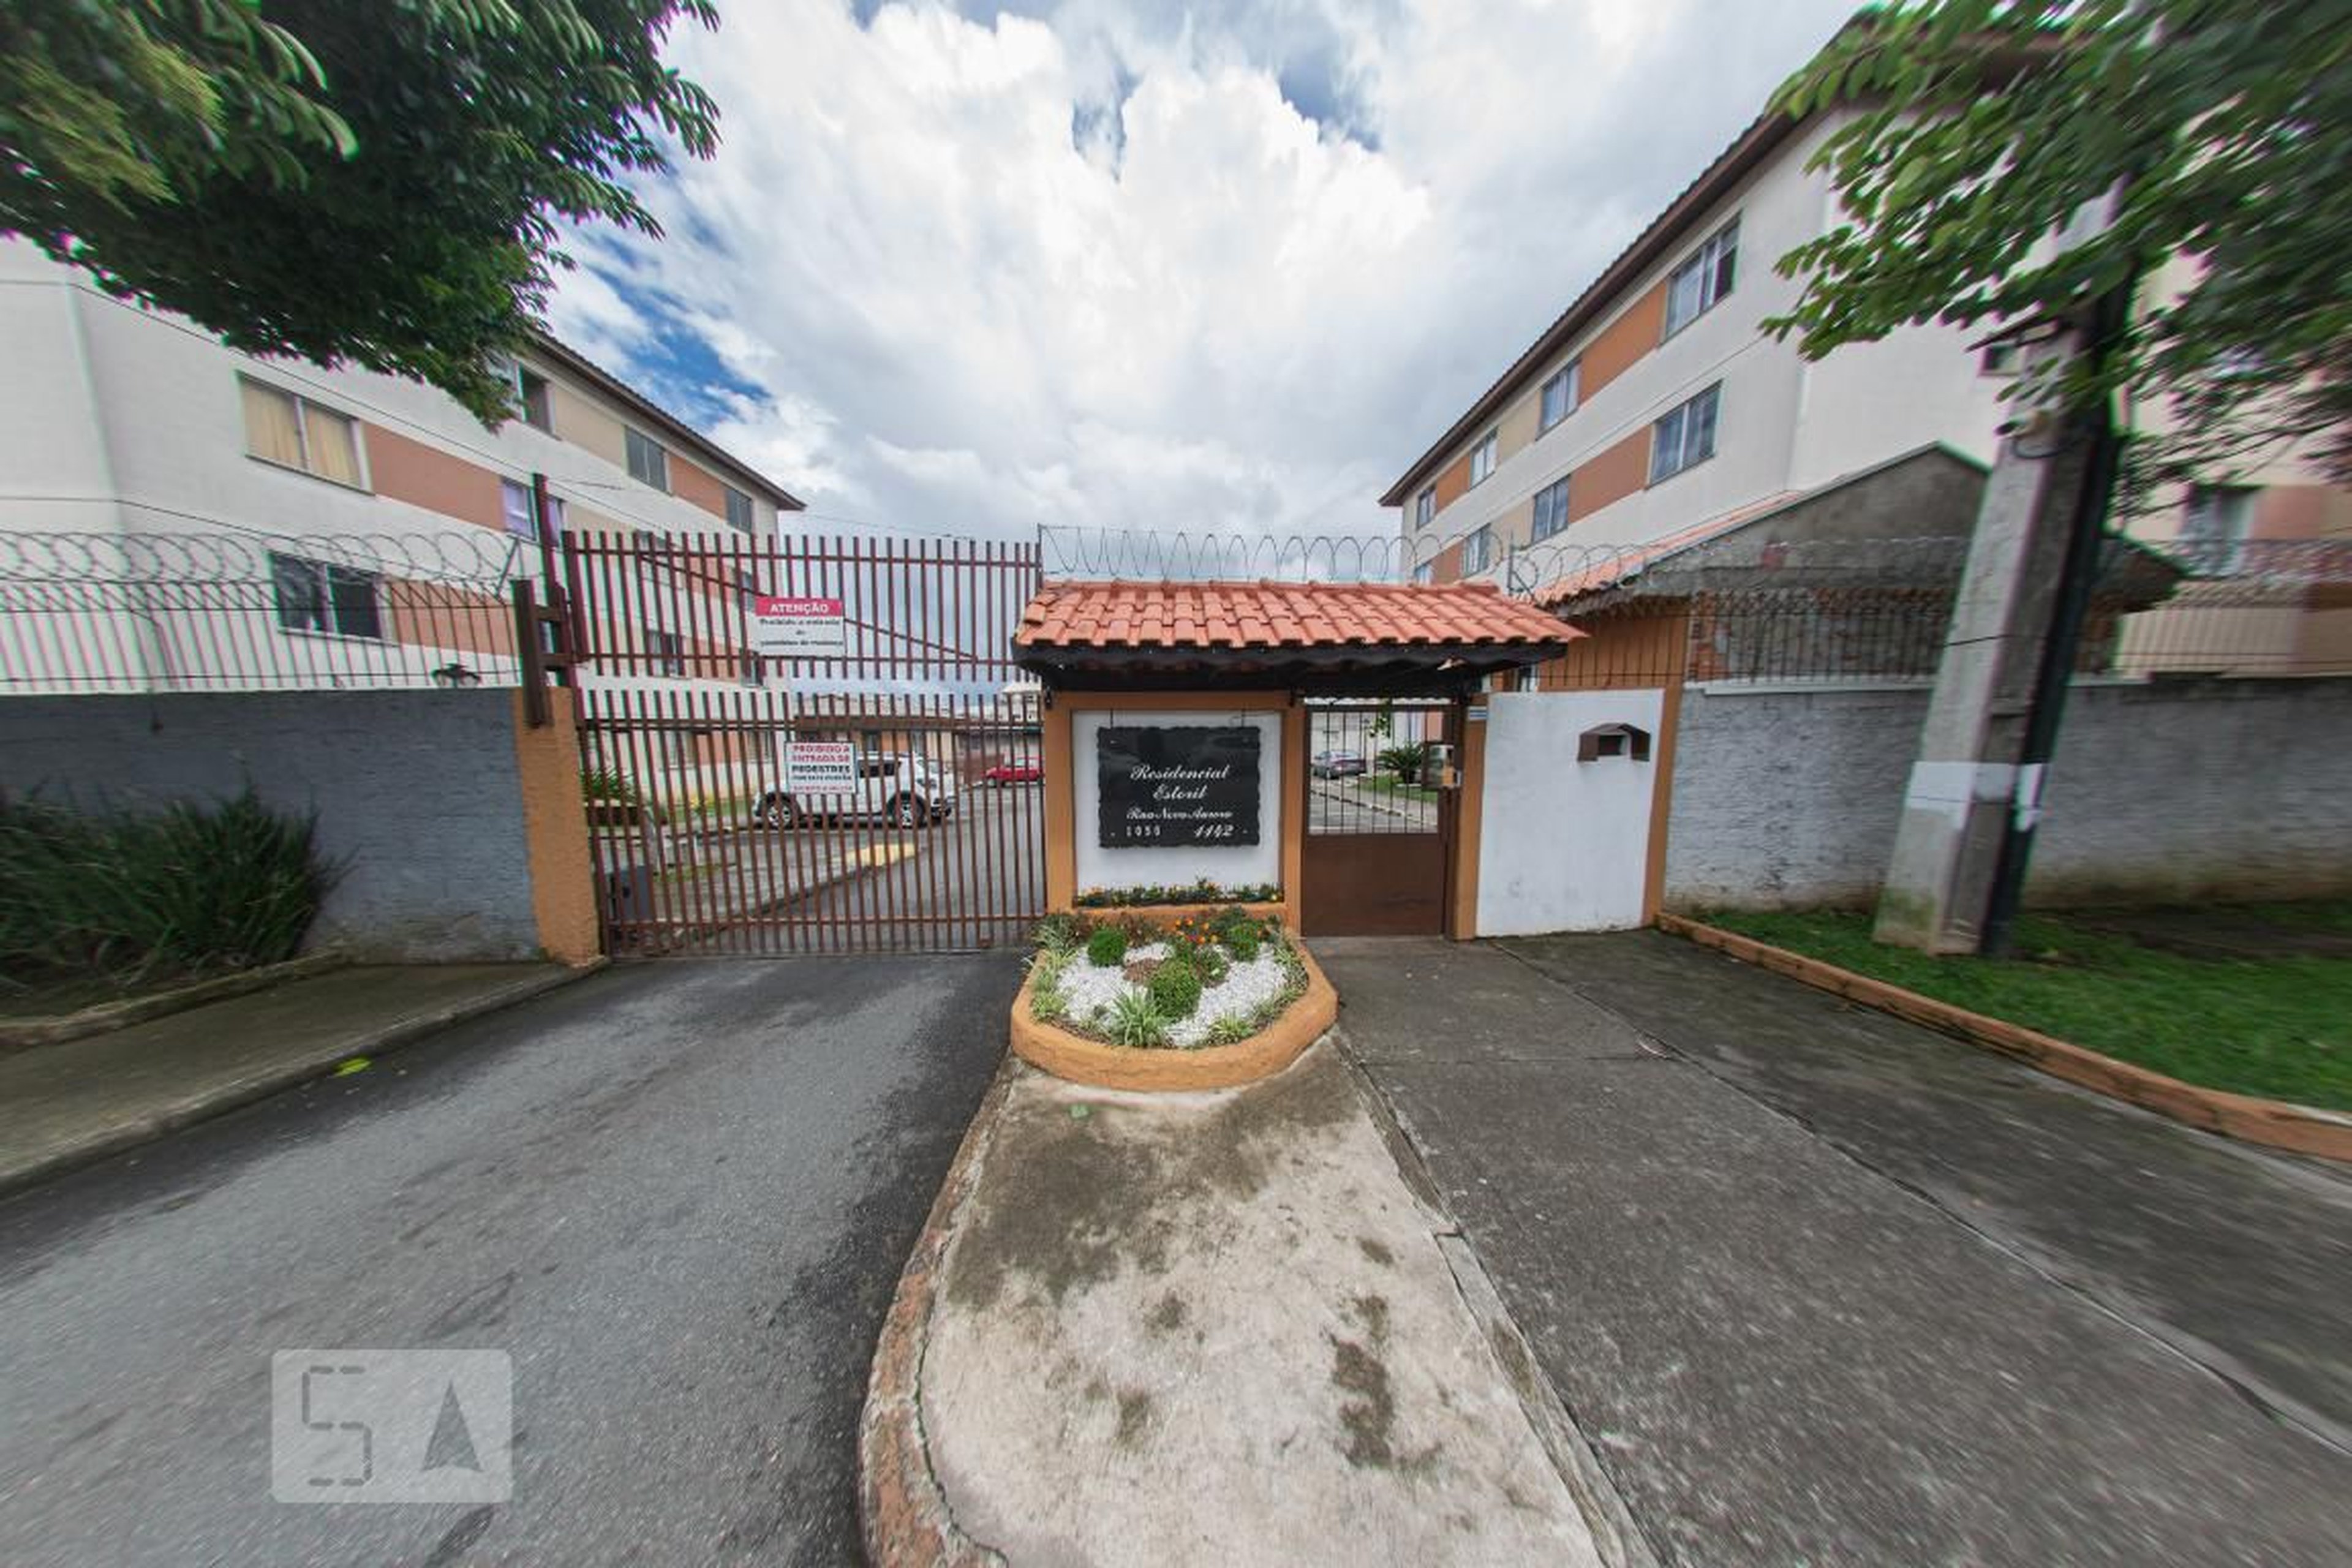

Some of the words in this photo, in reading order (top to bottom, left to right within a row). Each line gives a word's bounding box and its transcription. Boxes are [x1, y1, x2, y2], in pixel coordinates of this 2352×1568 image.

[770, 601, 829, 615] ATENÇÃO
[1129, 764, 1230, 780] Residencial
[1153, 783, 1208, 801] Estoril
